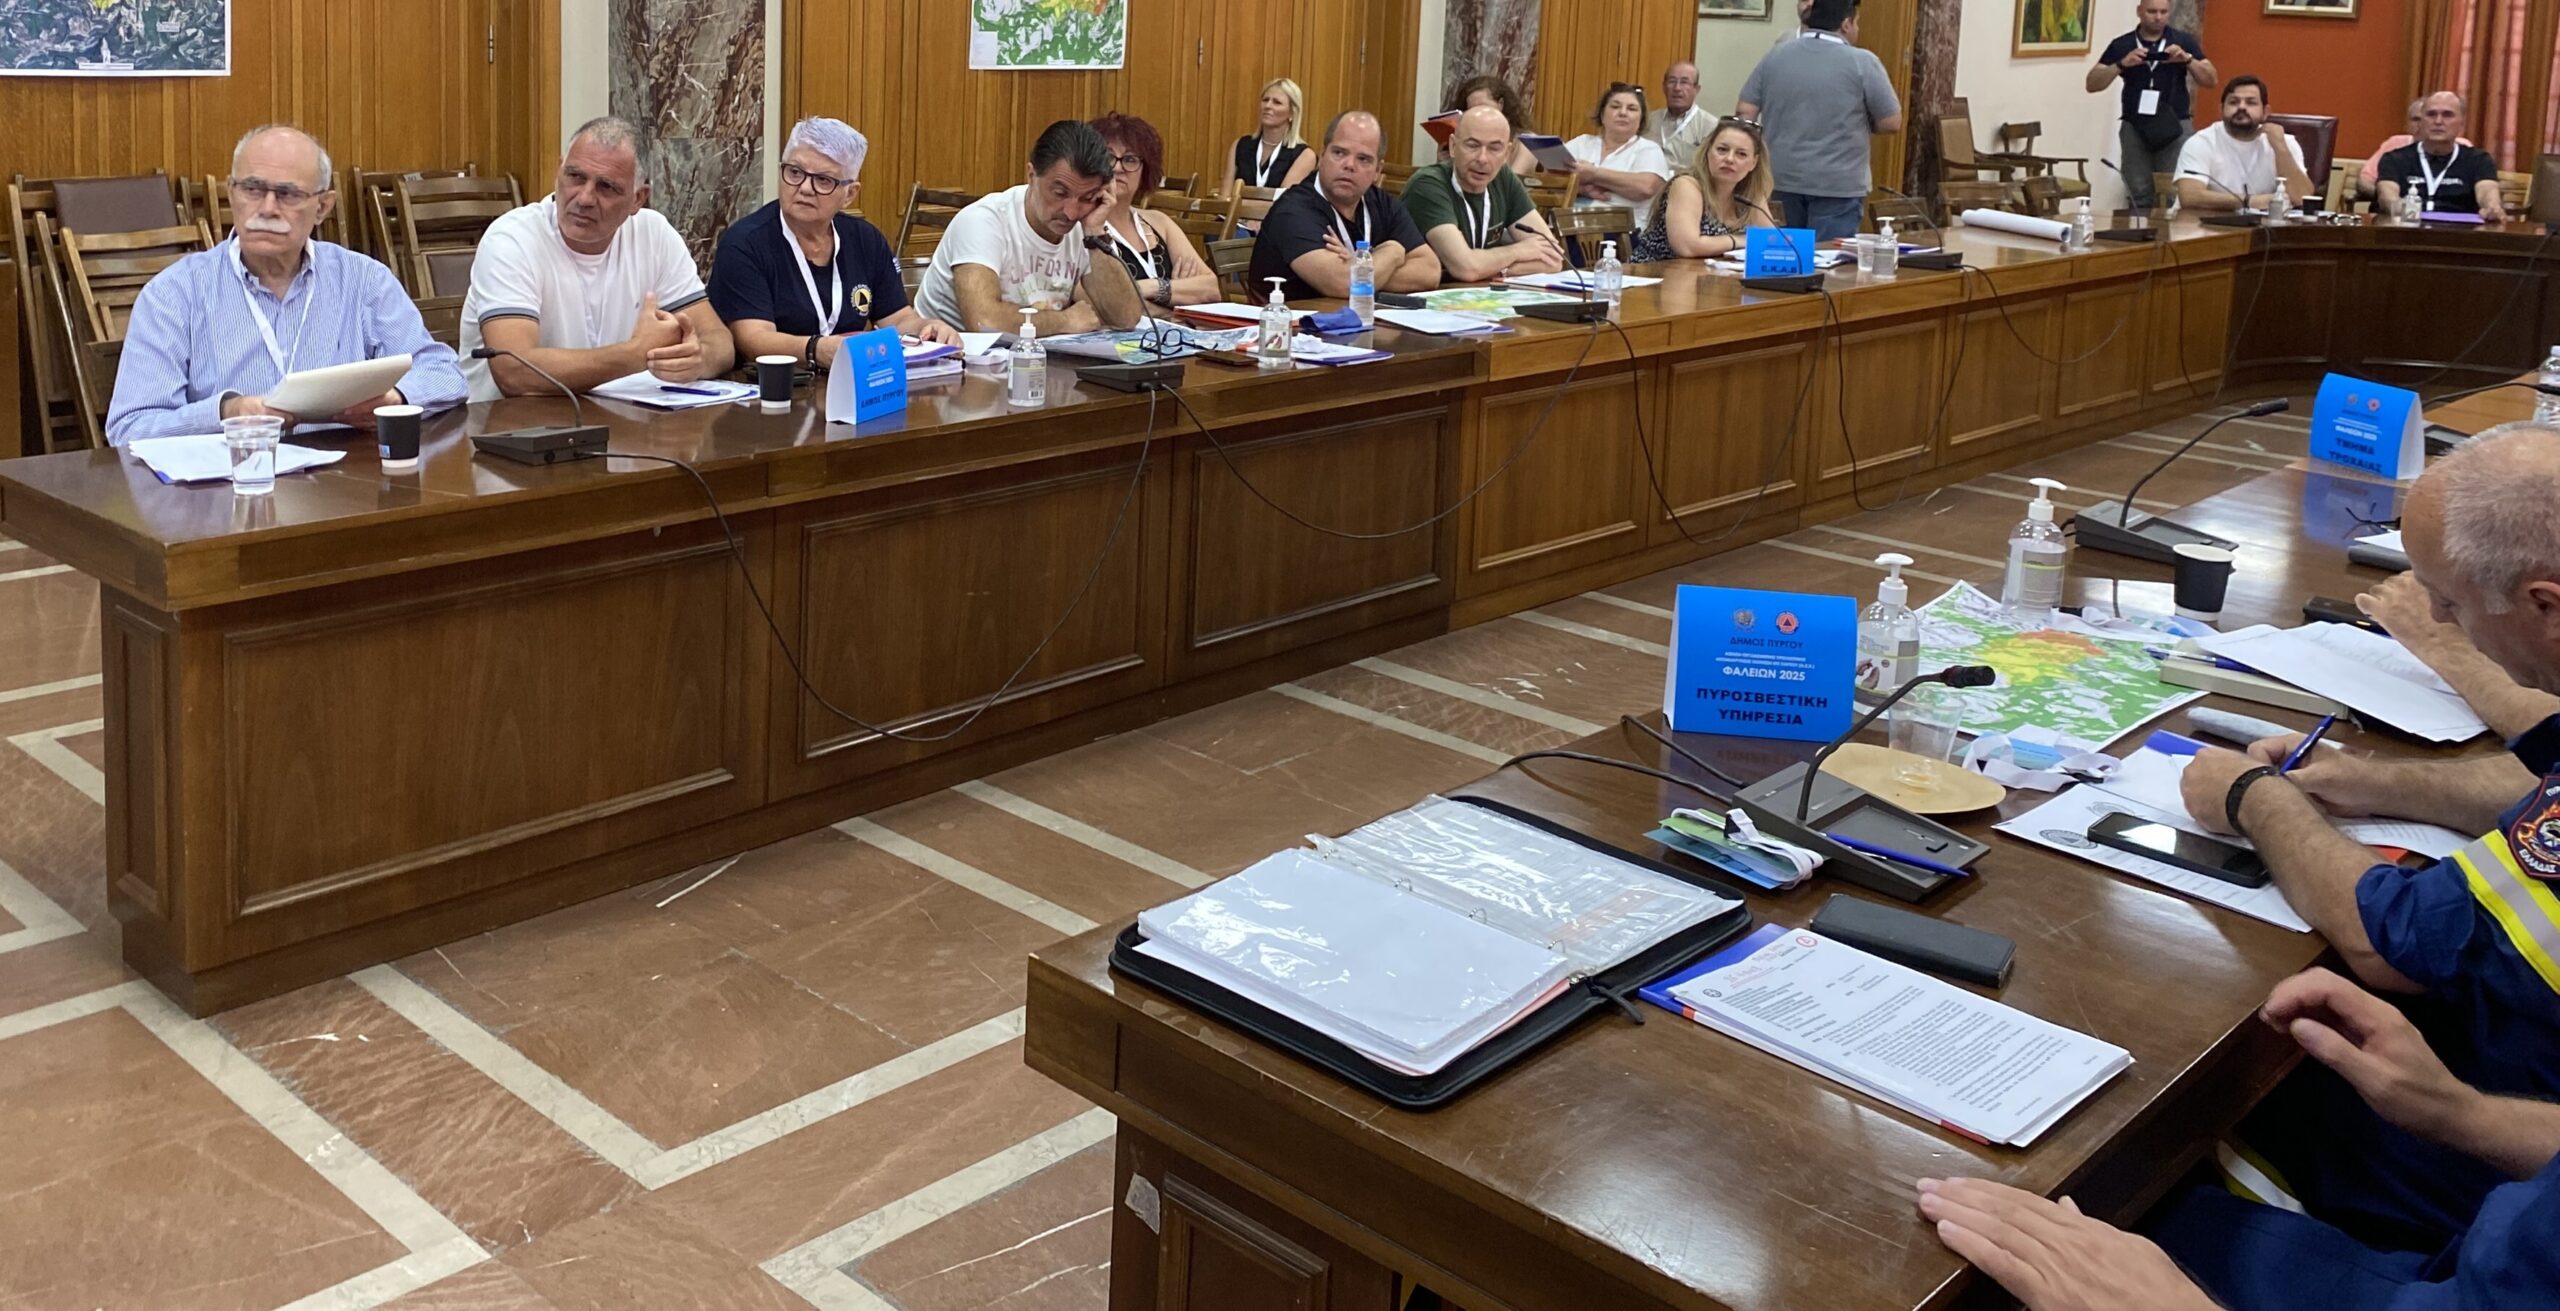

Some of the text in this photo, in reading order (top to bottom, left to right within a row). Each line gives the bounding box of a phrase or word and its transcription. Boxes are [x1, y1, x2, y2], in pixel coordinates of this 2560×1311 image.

[1730, 636, 1804, 649] ΔΗΜΟΣ ΠΥΡΓΟΥ
[1722, 666, 1806, 681] ΦΑΛΕΙΩΝ 2025
[1696, 687, 1828, 708] ΠΥΡΟΣΒΕΣΤΙΚΗ
[1718, 709, 1804, 725] ΥΠΗΡΕΣΙΑ
